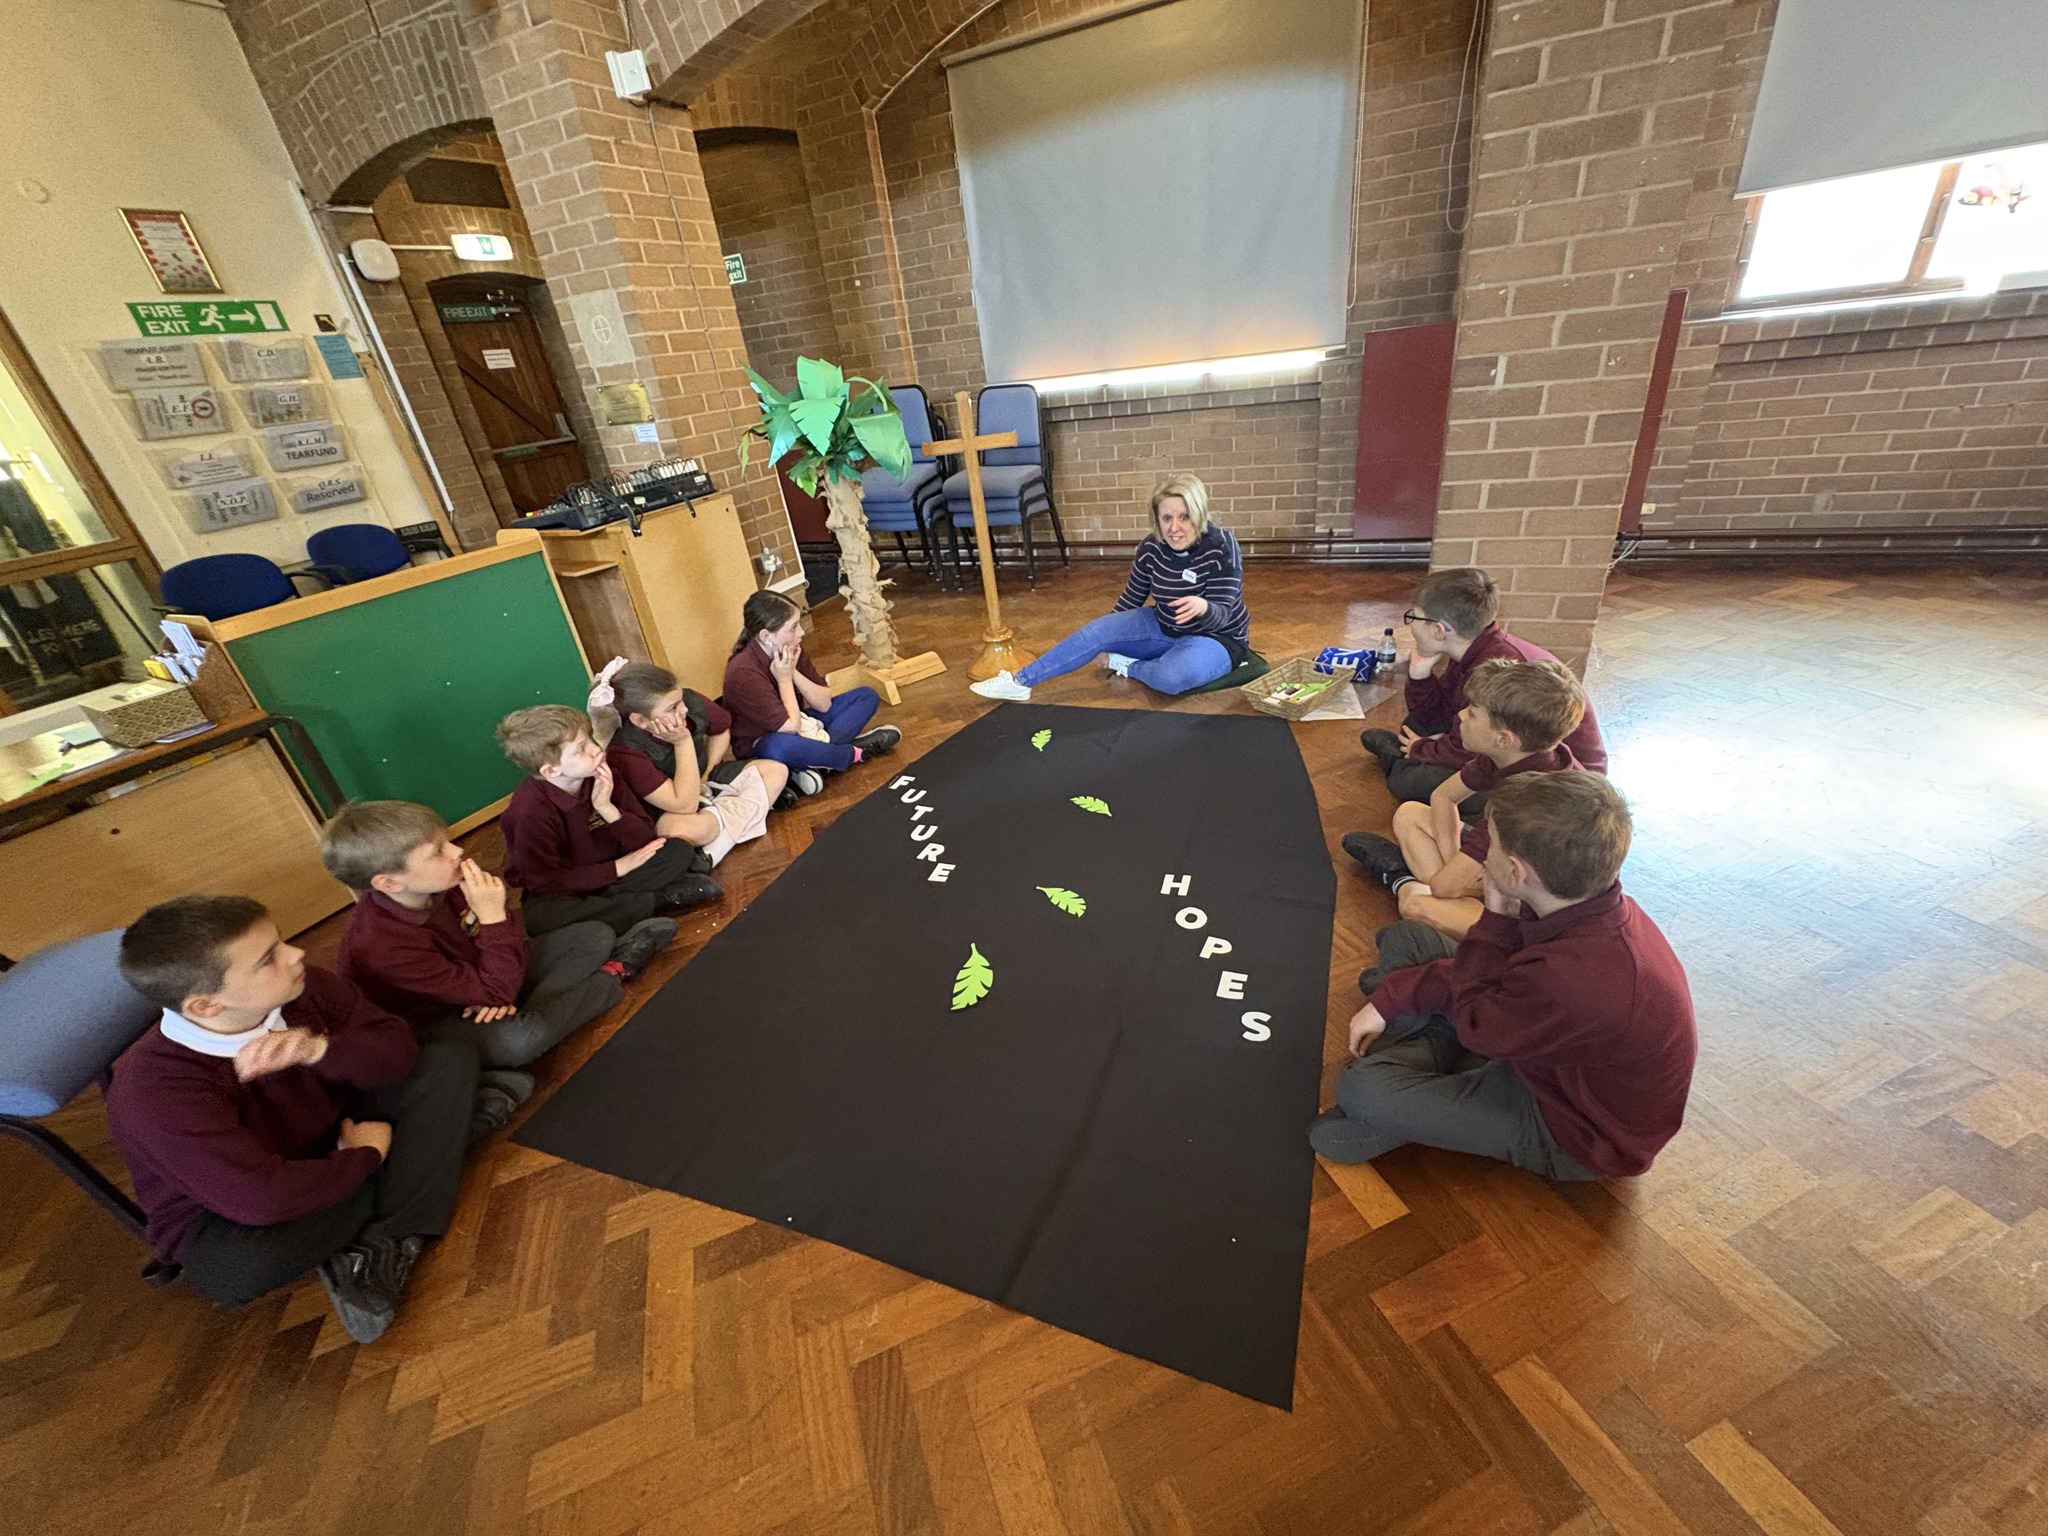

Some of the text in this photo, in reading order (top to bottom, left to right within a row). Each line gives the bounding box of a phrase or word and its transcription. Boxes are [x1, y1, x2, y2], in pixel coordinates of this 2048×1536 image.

[725, 260, 741, 270] Fire
[728, 270, 743, 281] exit
[136, 305, 186, 318] FIRE
[443, 306, 488, 318] FIRE EXIT
[145, 320, 191, 334] EXIT
[285, 446, 338, 460] TEARFUND
[306, 483, 355, 502] Reserved
[888, 775, 957, 883] FUTURE
[1160, 873, 1272, 1042] HOPES
